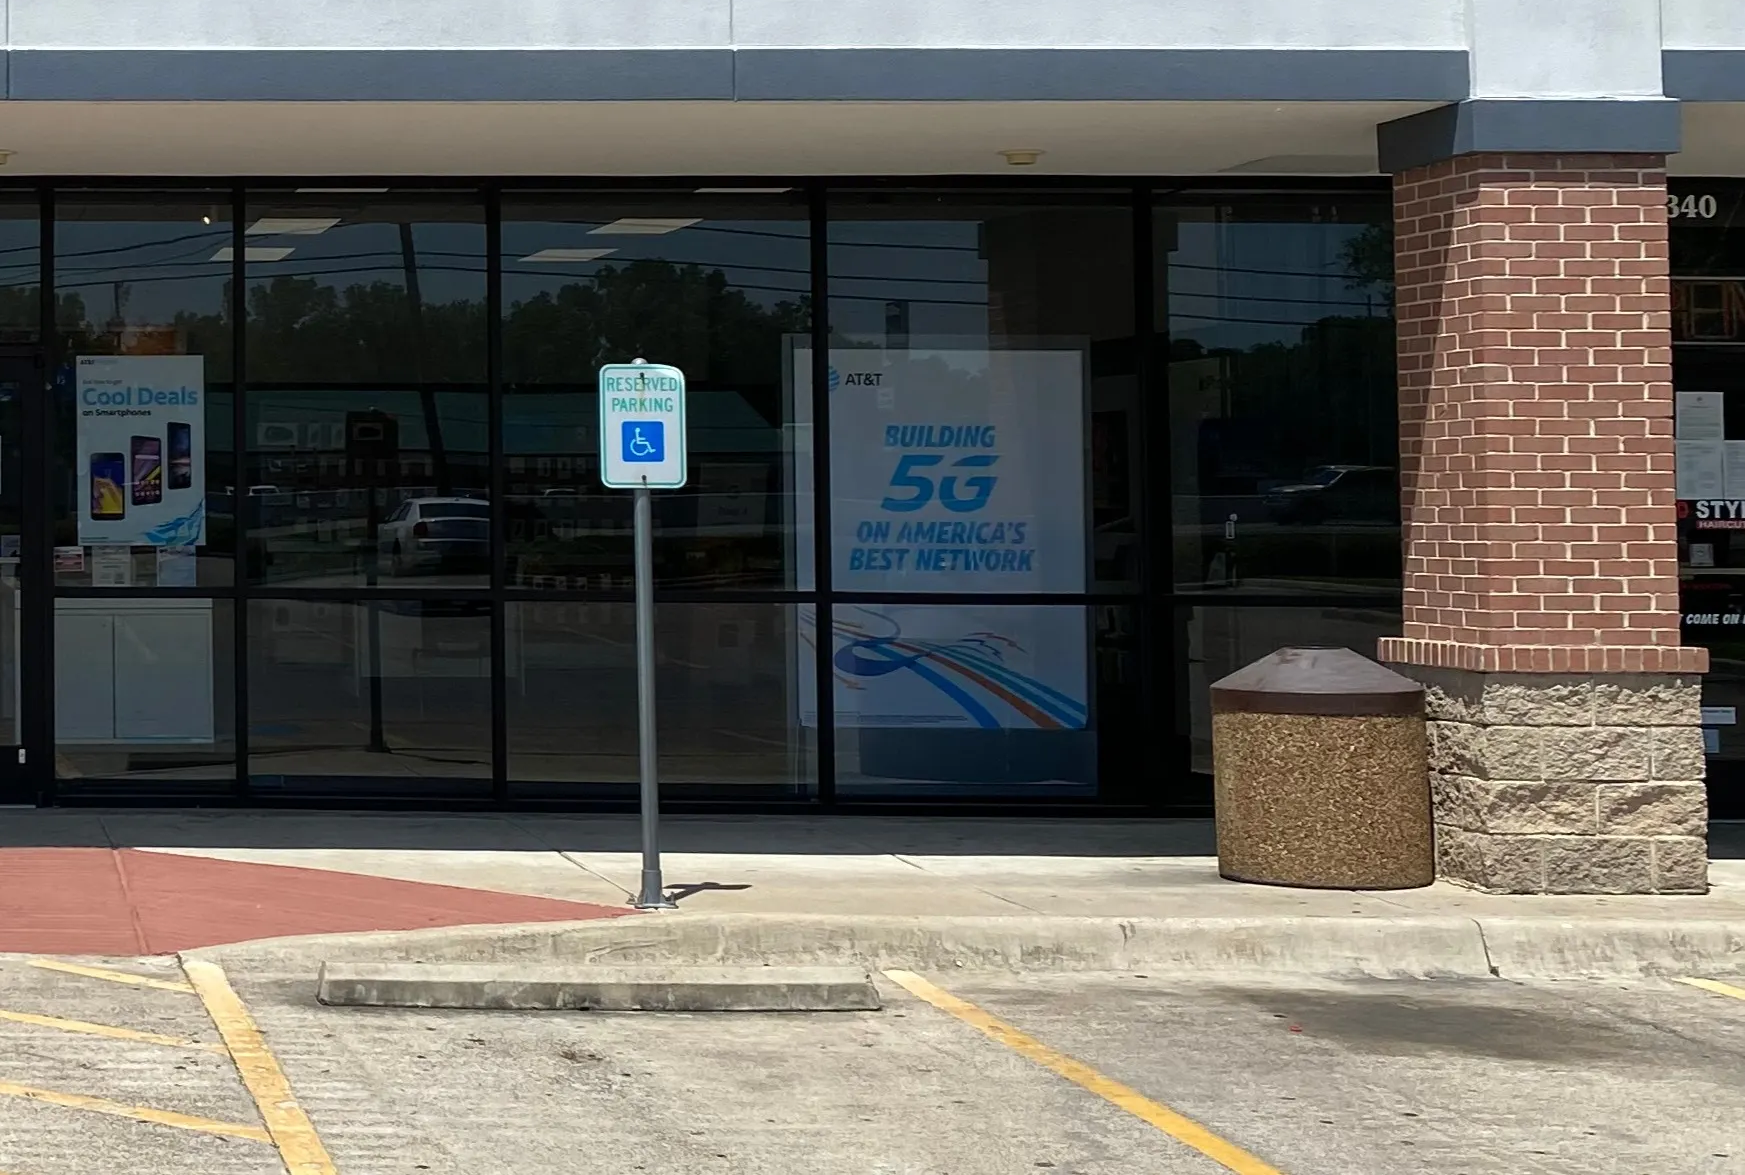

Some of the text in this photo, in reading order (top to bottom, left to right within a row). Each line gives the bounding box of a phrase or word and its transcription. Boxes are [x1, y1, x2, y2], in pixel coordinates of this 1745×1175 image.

[1667, 194, 1717, 219] 340
[606, 377, 677, 392] RESERVED
[845, 372, 883, 386] AT&T
[82, 386, 198, 405] Cool Deals
[611, 397, 673, 412] PARKING
[95, 408, 152, 418] Smartphones
[884, 424, 996, 448] BUILDING
[880, 454, 1003, 513] 5G
[856, 521, 1028, 545] ON AMERICA'S
[849, 548, 1036, 572] BEST NETWORK
[1686, 613, 1720, 625] COME
[1722, 613, 1741, 625] ON
